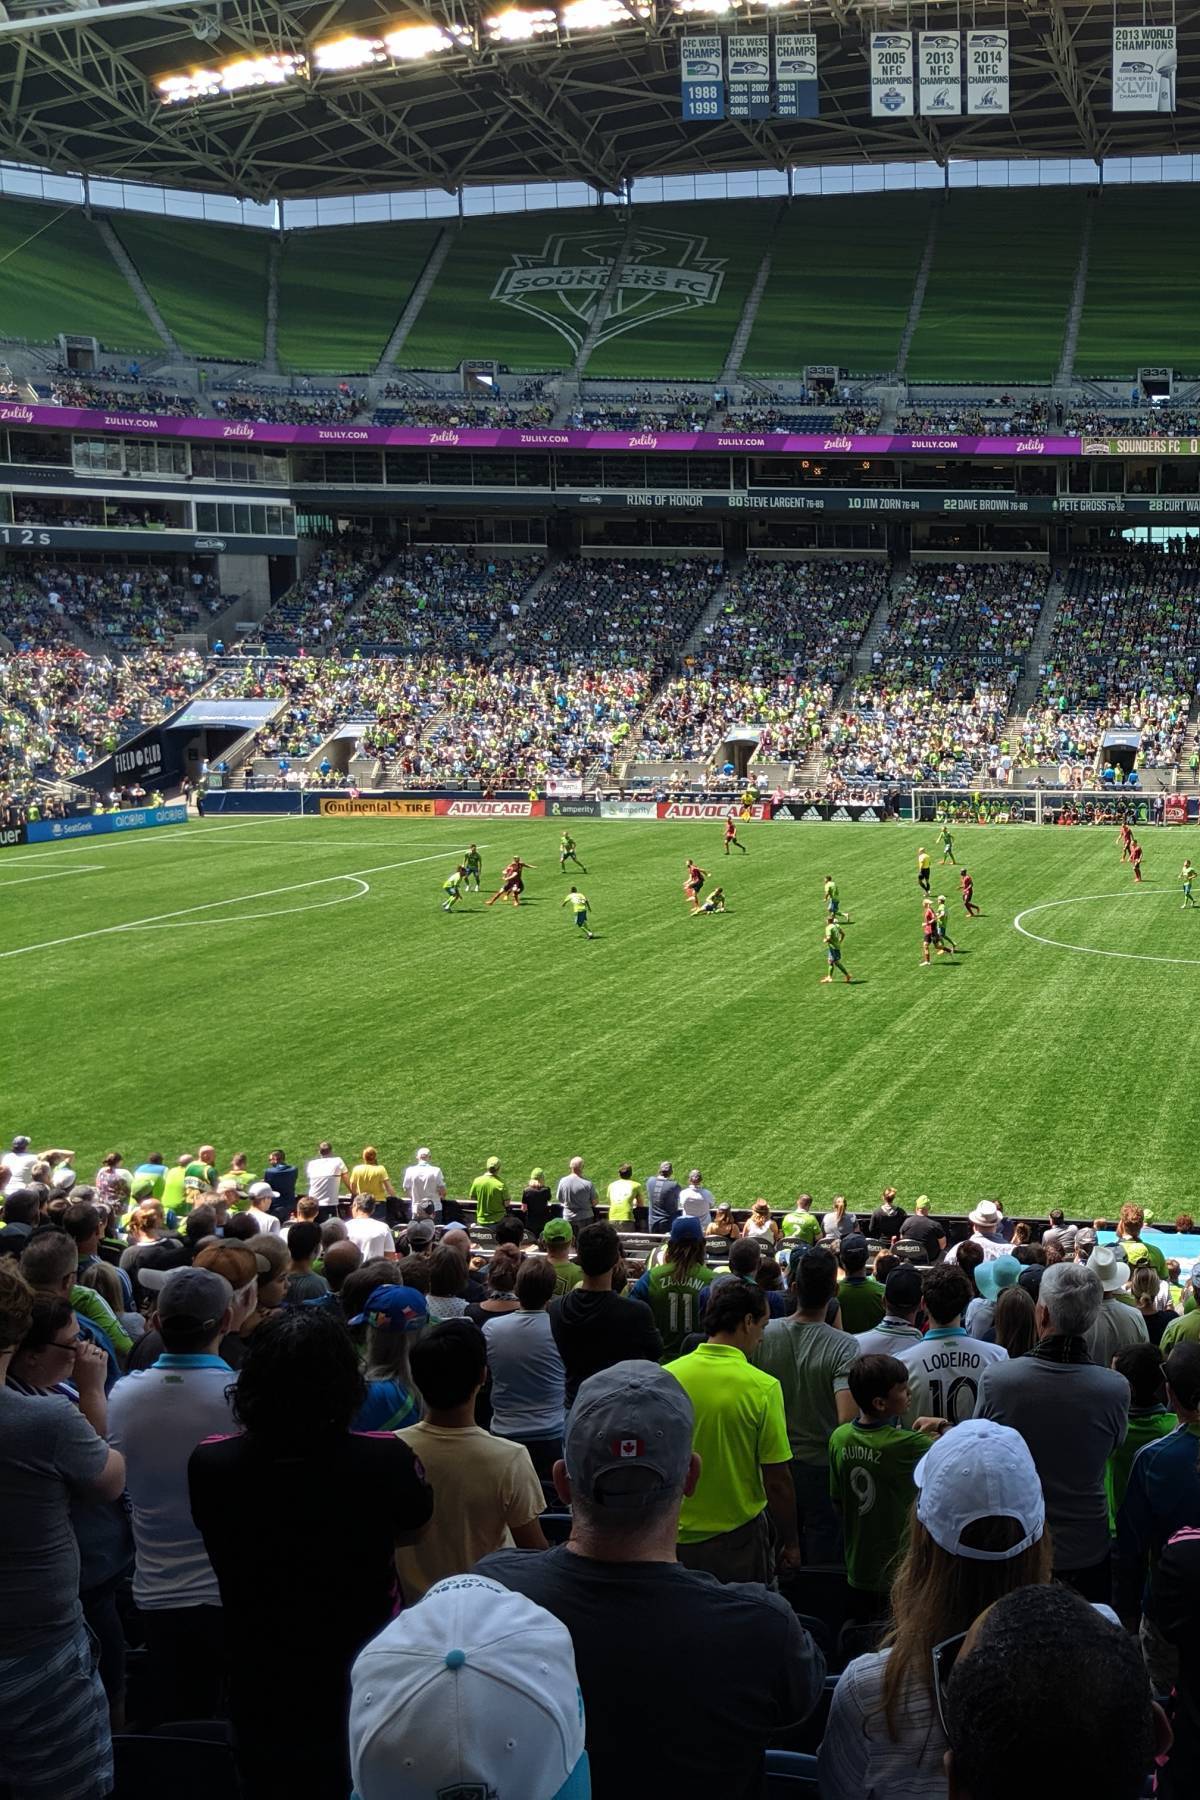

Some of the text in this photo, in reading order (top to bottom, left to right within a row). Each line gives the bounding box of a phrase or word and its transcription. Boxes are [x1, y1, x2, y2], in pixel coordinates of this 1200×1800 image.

[1116, 29, 1173, 40] 2013 WORLD
[683, 38, 720, 47] AFC WEST
[777, 37, 792, 45] NFC
[1116, 40, 1173, 50] CHAMPIONS
[683, 49, 720, 58] CHAMPS
[730, 48, 768, 57] CHAMPS
[777, 47, 815, 56] CHAMPS
[974, 51, 1002, 63] 2014
[878, 53, 905, 64] 2005
[926, 52, 953, 64] 2013
[882, 66, 902, 75] NFC
[930, 65, 950, 75] NFC
[978, 65, 998, 74] NFC
[688, 87, 717, 98] 1988
[1115, 82, 1158, 93] XLVIII
[689, 102, 717, 114] 1999
[675, 278, 706, 293] FC
[105, 417, 158, 428] ZULILY.COM
[1117, 440, 1180, 453] SOUNDERS FC
[1191, 440, 1197, 453] 0
[627, 495, 703, 506] RING OF HONOR
[729, 497, 805, 507] 80 STEVE LARGENT
[849, 498, 900, 508] 10 JIM ZORN
[944, 500, 957, 509] 22
[958, 500, 977, 510] DAVE
[980, 500, 1009, 510] BROWN
[1059, 501, 1106, 511] PETE GROSS
[1149, 501, 1163, 511] 28
[1164, 501, 1184, 511] CURT
[115, 752, 135, 773] FIELD
[144, 744, 161, 764] CLUB
[325, 800, 431, 814] Continental TIRE
[449, 802, 531, 814] ADVOCARE
[64, 822, 93, 833] SeatGeek
[668, 1293, 692, 1332] 11
[923, 1352, 980, 1373] LODEIRO
[930, 1376, 978, 1423] 10
[842, 1446, 882, 1464] RUIDIAZ
[851, 1466, 876, 1516] 9
